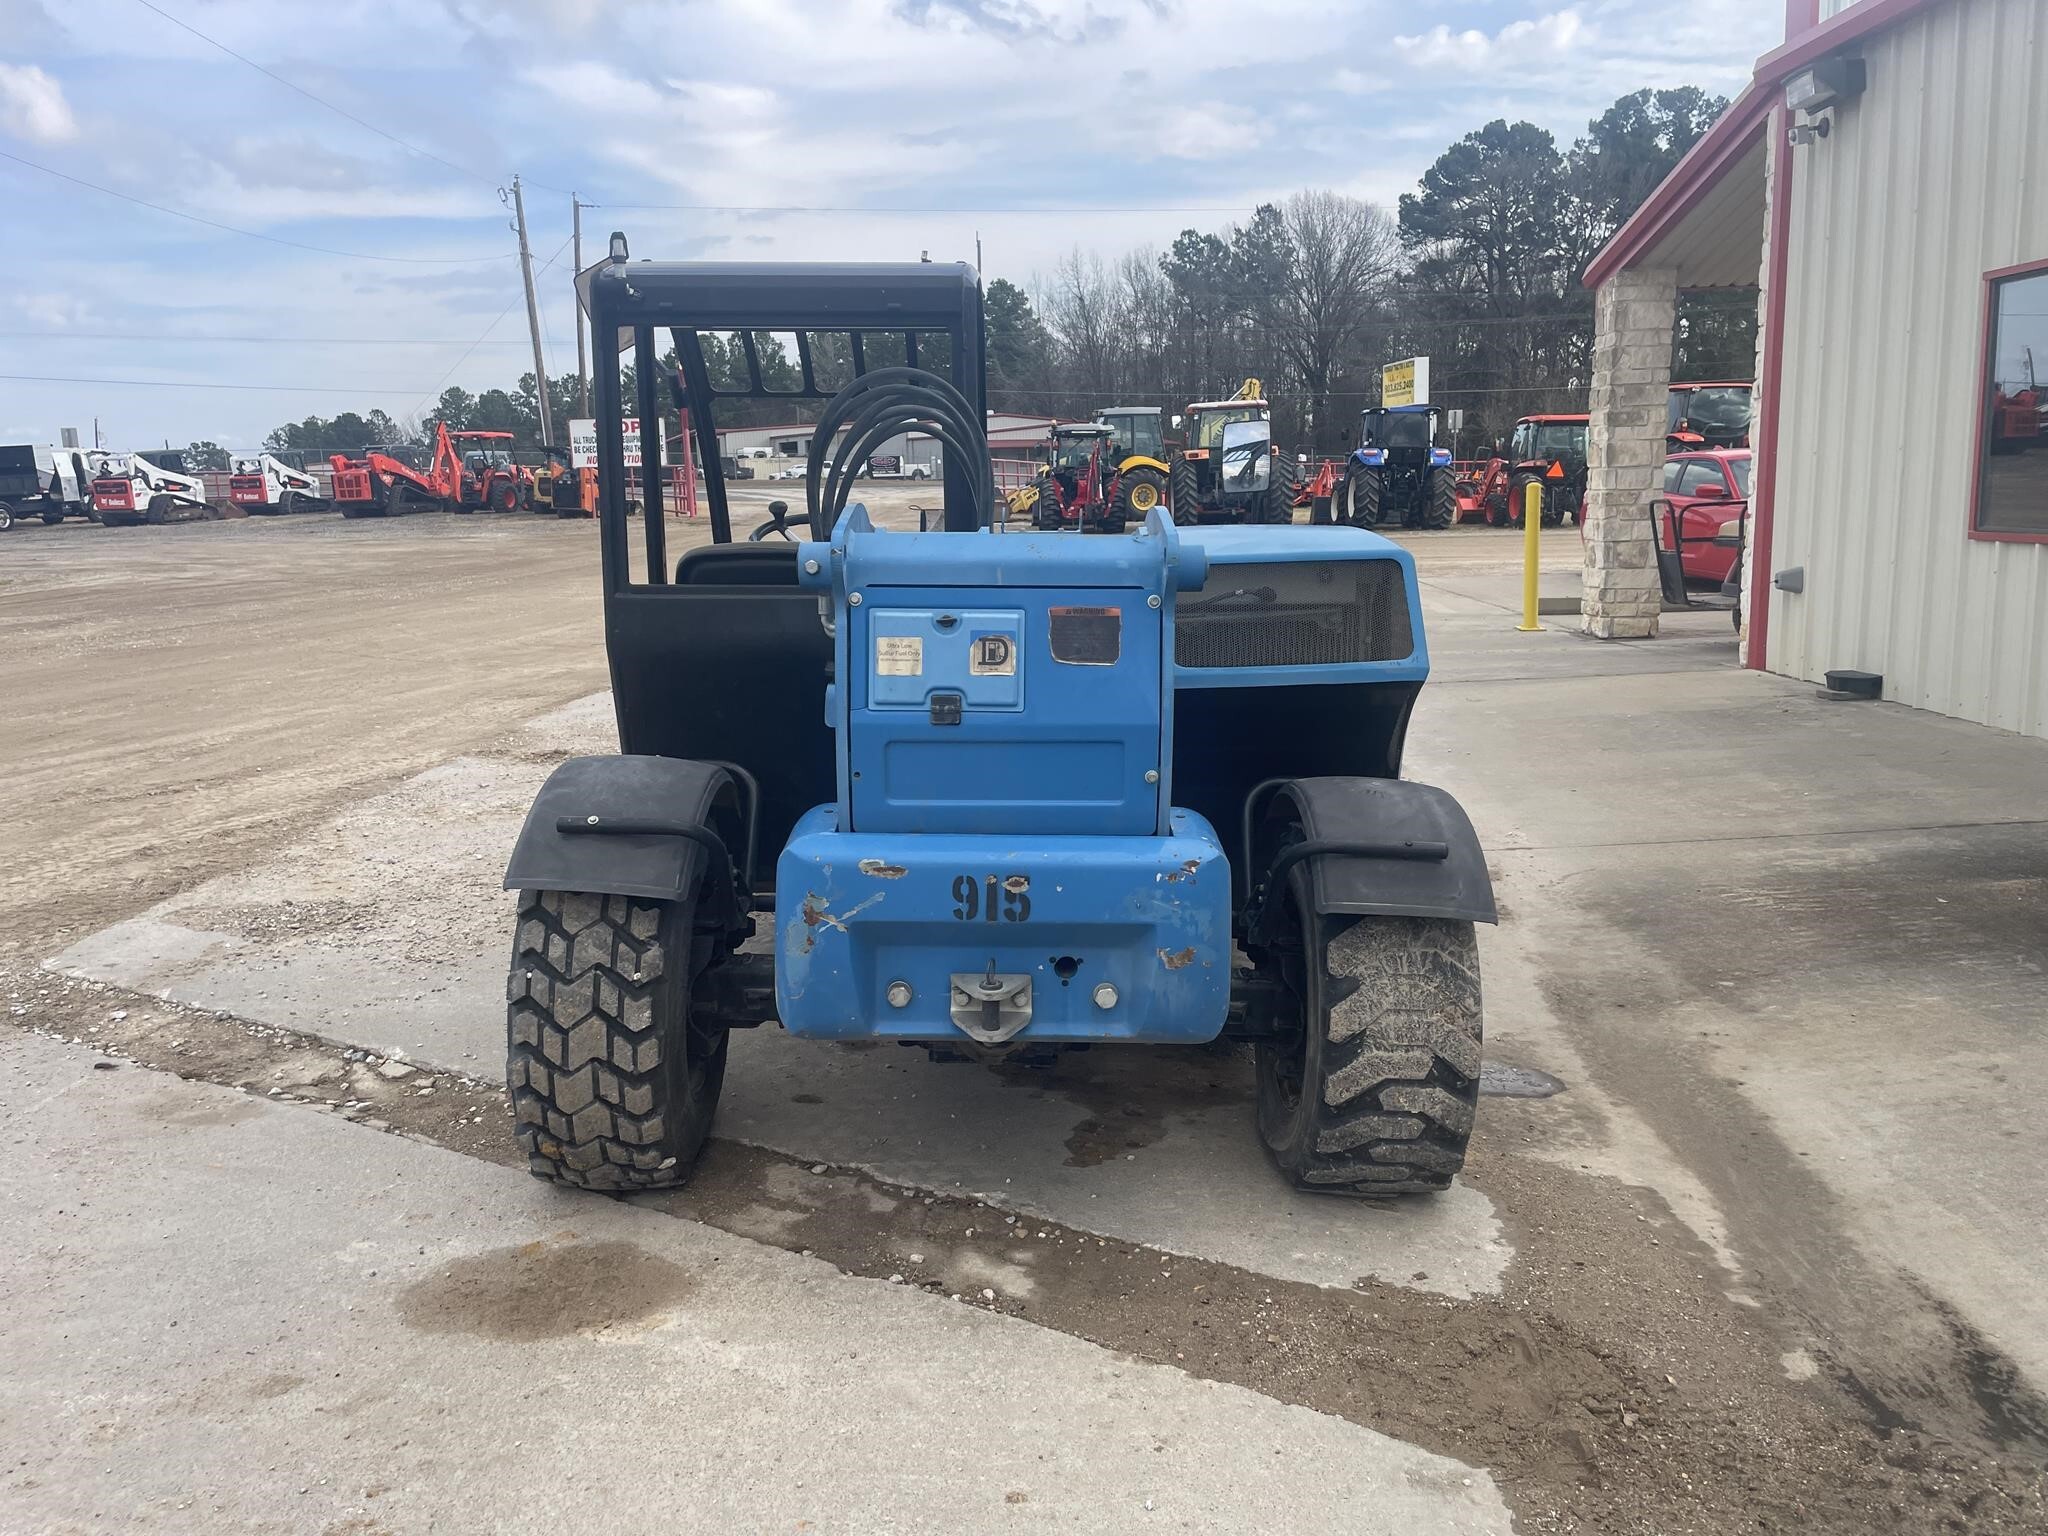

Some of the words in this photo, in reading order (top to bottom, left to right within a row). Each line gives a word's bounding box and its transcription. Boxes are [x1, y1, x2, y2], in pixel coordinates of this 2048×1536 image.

[574, 446, 581, 454] BE
[582, 445, 597, 453] CHEC
[623, 445, 633, 453] HRU
[586, 456, 598, 464] NO
[978, 637, 1009, 665] D
[952, 874, 1031, 922] 915
